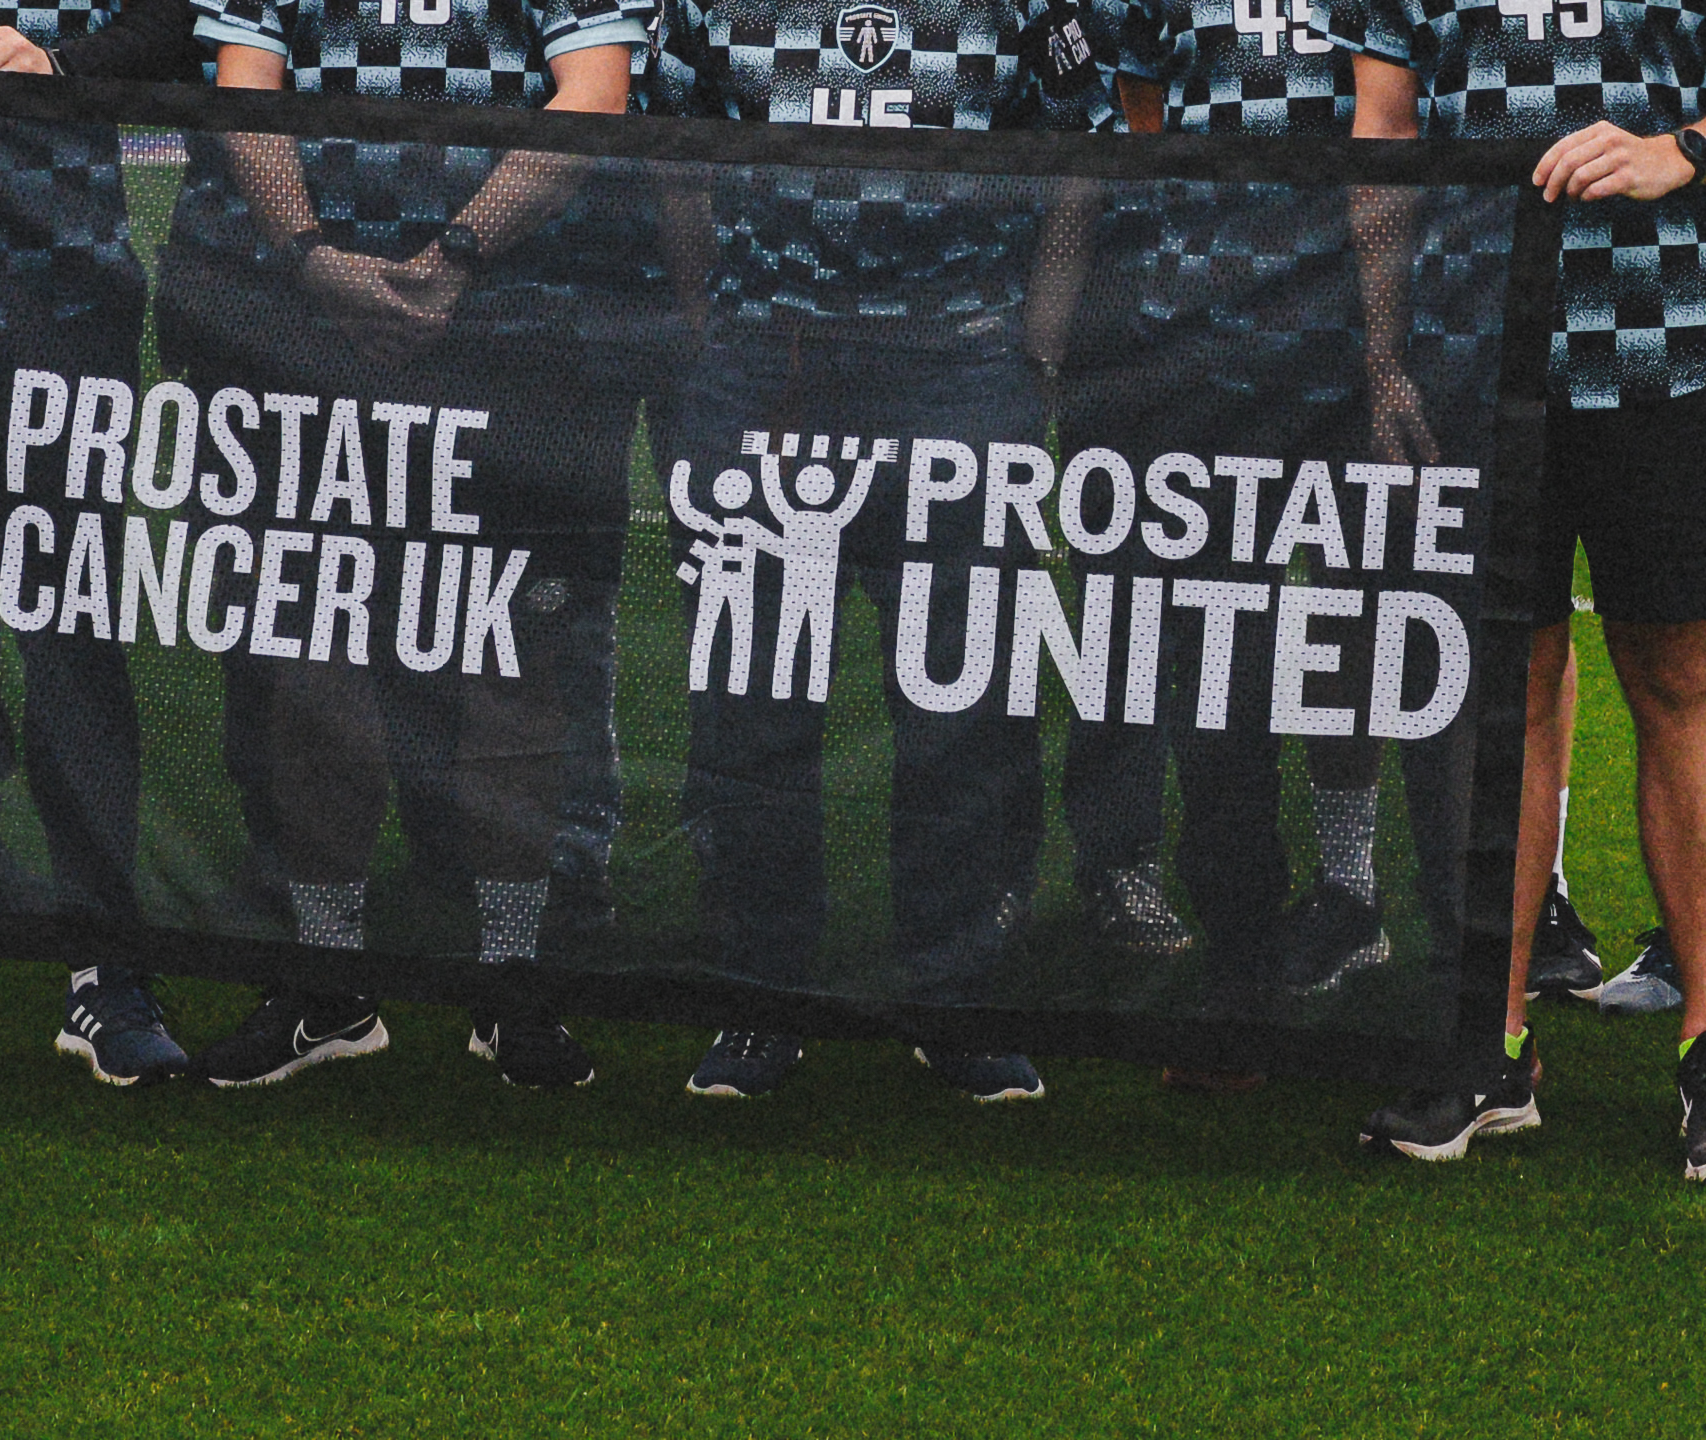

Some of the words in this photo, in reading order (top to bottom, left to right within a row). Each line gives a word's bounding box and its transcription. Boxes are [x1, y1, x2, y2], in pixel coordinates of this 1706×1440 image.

[3, 368, 490, 536] PROSTATE
[904, 438, 1480, 576] PROSTATE
[396, 543, 531, 679] UK
[895, 563, 1475, 741] UNITED
